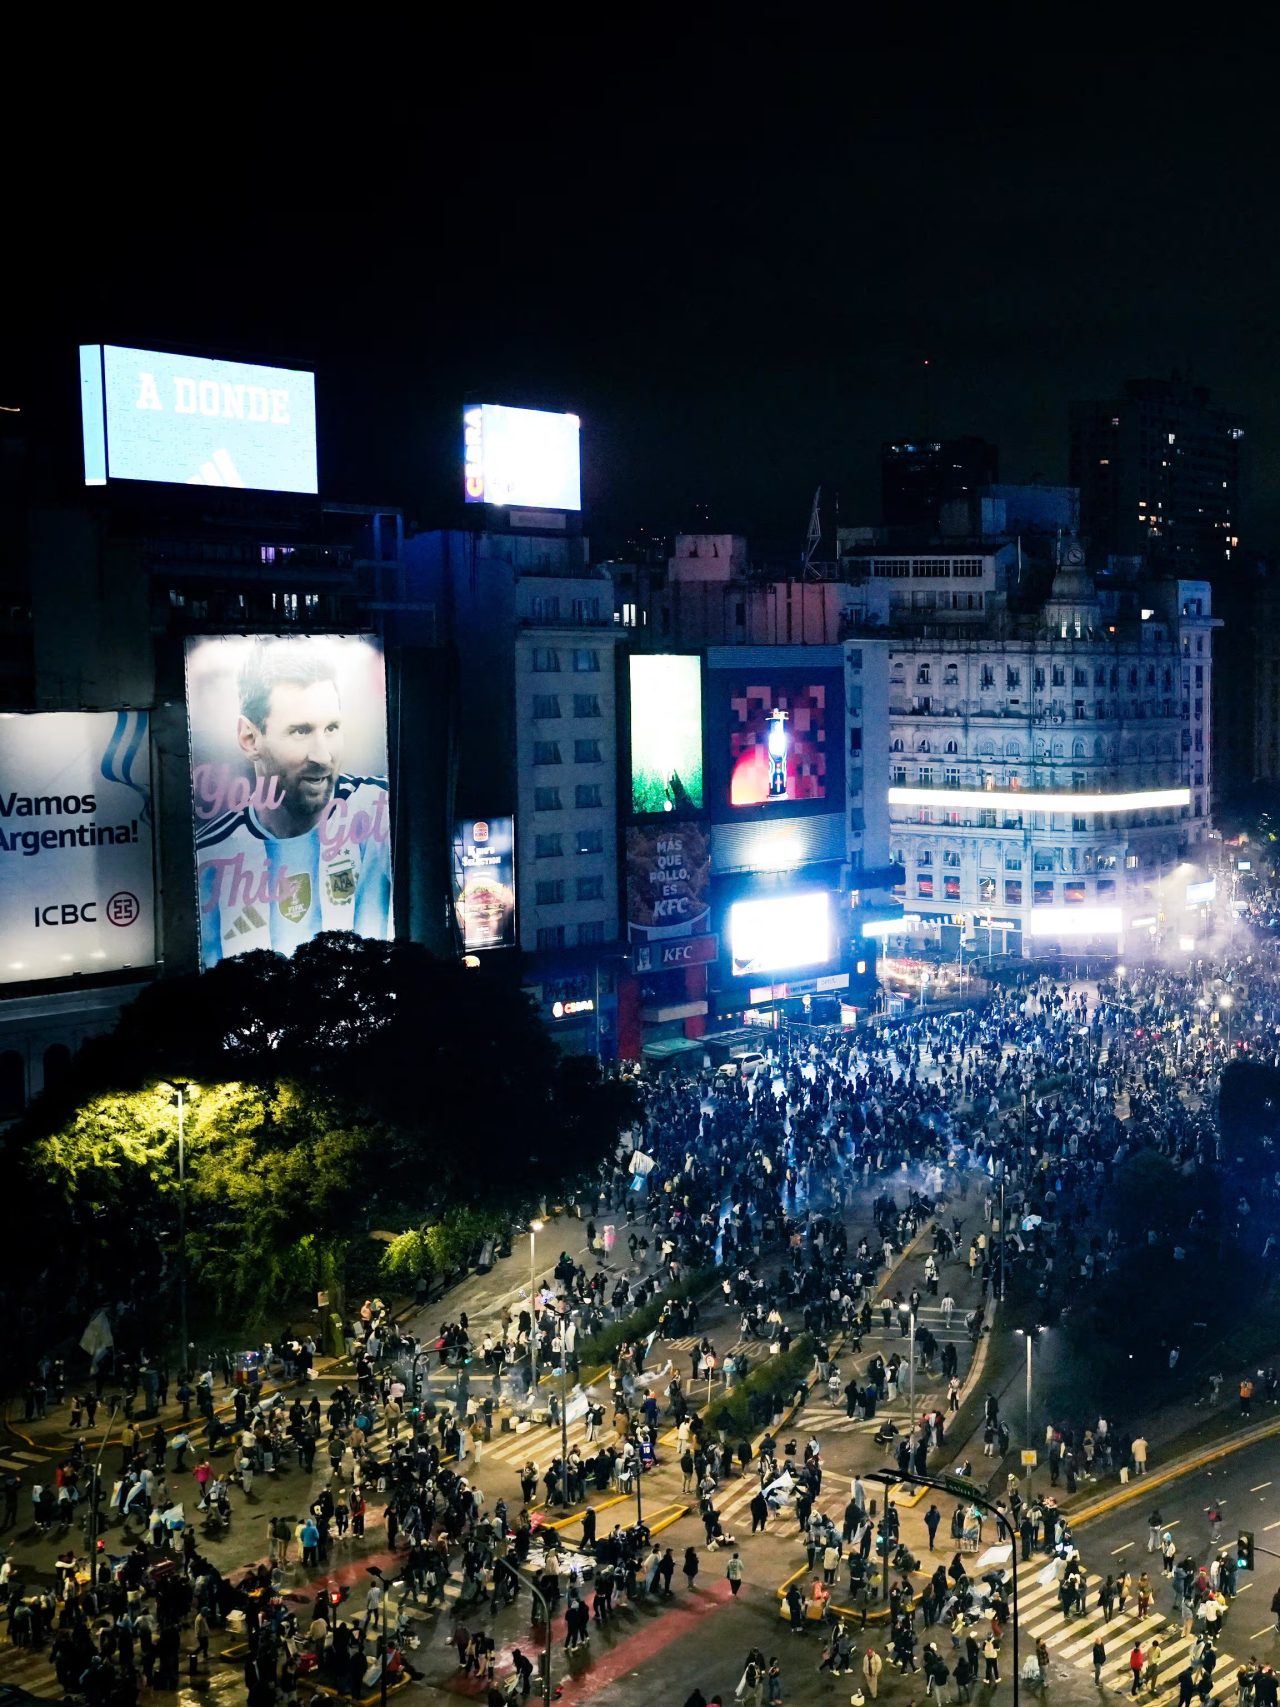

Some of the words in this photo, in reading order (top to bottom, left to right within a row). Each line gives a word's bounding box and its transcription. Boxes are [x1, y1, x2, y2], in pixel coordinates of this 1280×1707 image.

[135, 371, 163, 411] A
[173, 376, 291, 425] DONDE
[193, 762, 286, 819] You
[0, 792, 97, 817] Vamos
[319, 790, 389, 862] Got
[656, 837, 683, 853] MÁS
[657, 854, 682, 869] QUE
[198, 852, 294, 914] This
[650, 869, 691, 883] POLLO,
[662, 884, 678, 896] ES
[34, 902, 97, 927] ICBC
[652, 897, 689, 917] KFC
[663, 945, 693, 962] KFC
